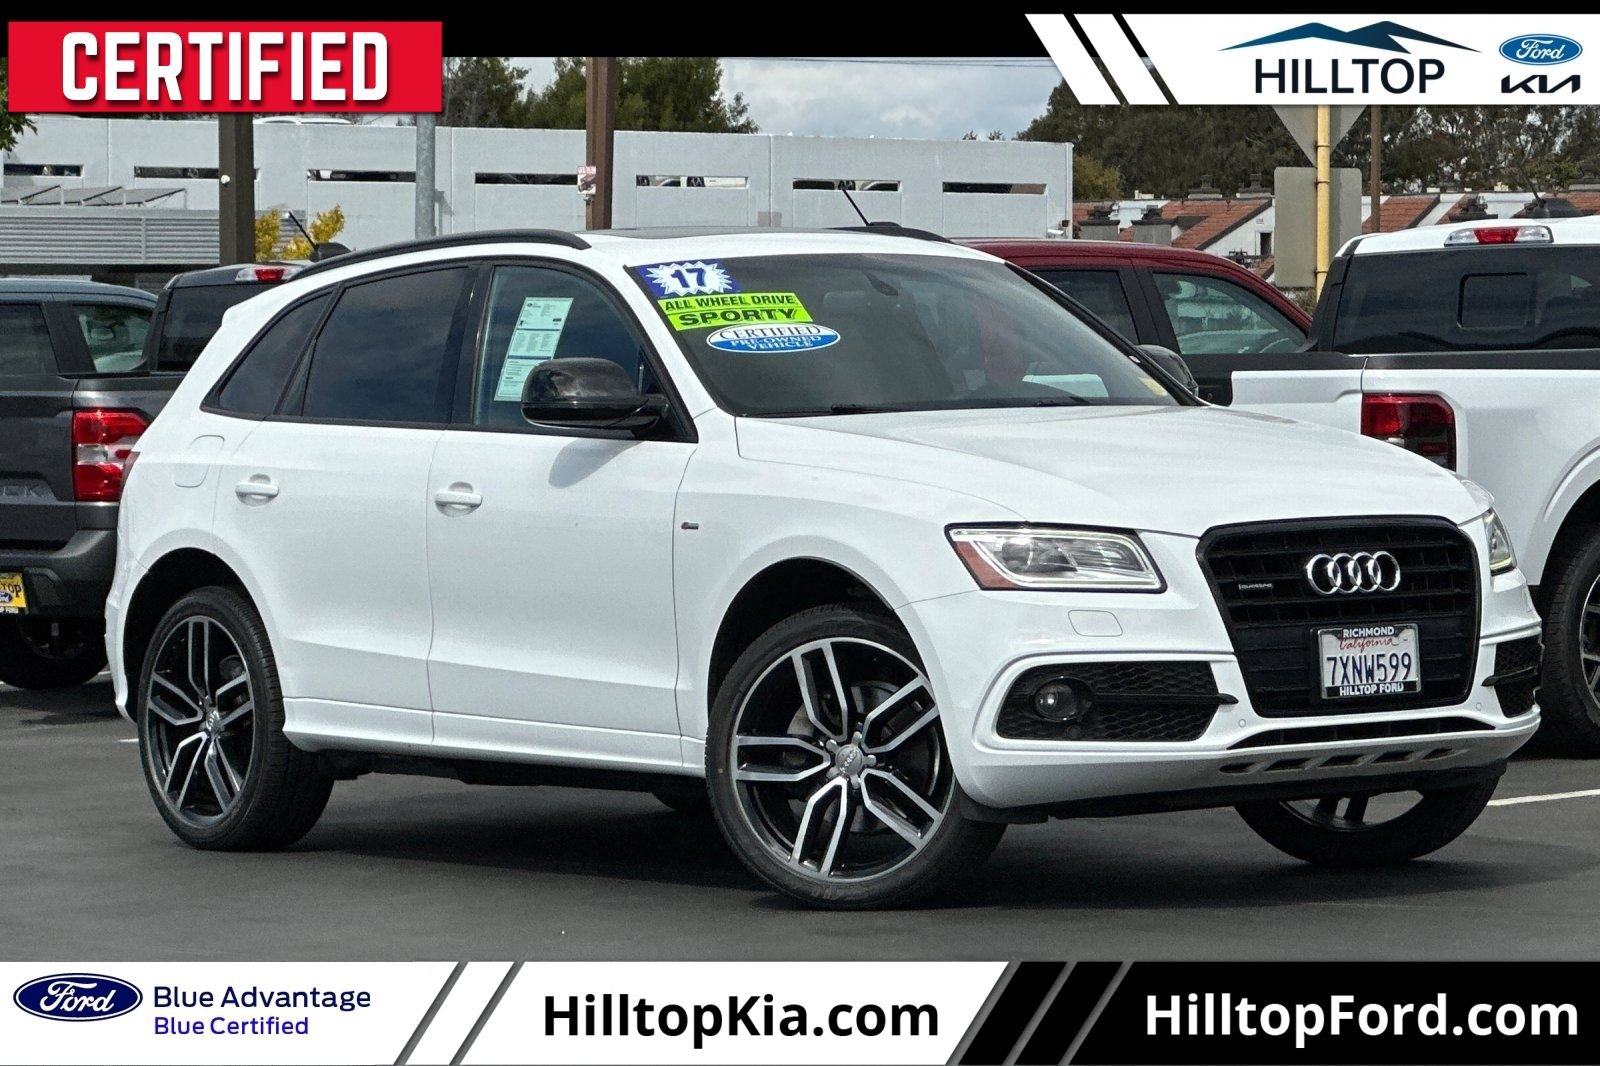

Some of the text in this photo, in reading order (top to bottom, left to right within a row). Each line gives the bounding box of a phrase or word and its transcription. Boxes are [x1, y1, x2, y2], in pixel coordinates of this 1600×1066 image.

[670, 267, 707, 289] 17
[665, 295, 796, 311] ALL WHEEL DRIVE
[679, 308, 797, 325] SPORTY
[719, 325, 821, 340] CERTIFIED
[730, 335, 822, 347] PRE-OWNED
[747, 340, 814, 350] VEHICLE
[1343, 626, 1394, 638] RICHMOND
[1340, 637, 1399, 654] California
[1326, 652, 1412, 686] 7XNW599
[1340, 682, 1404, 697] HILLTOP FORD
